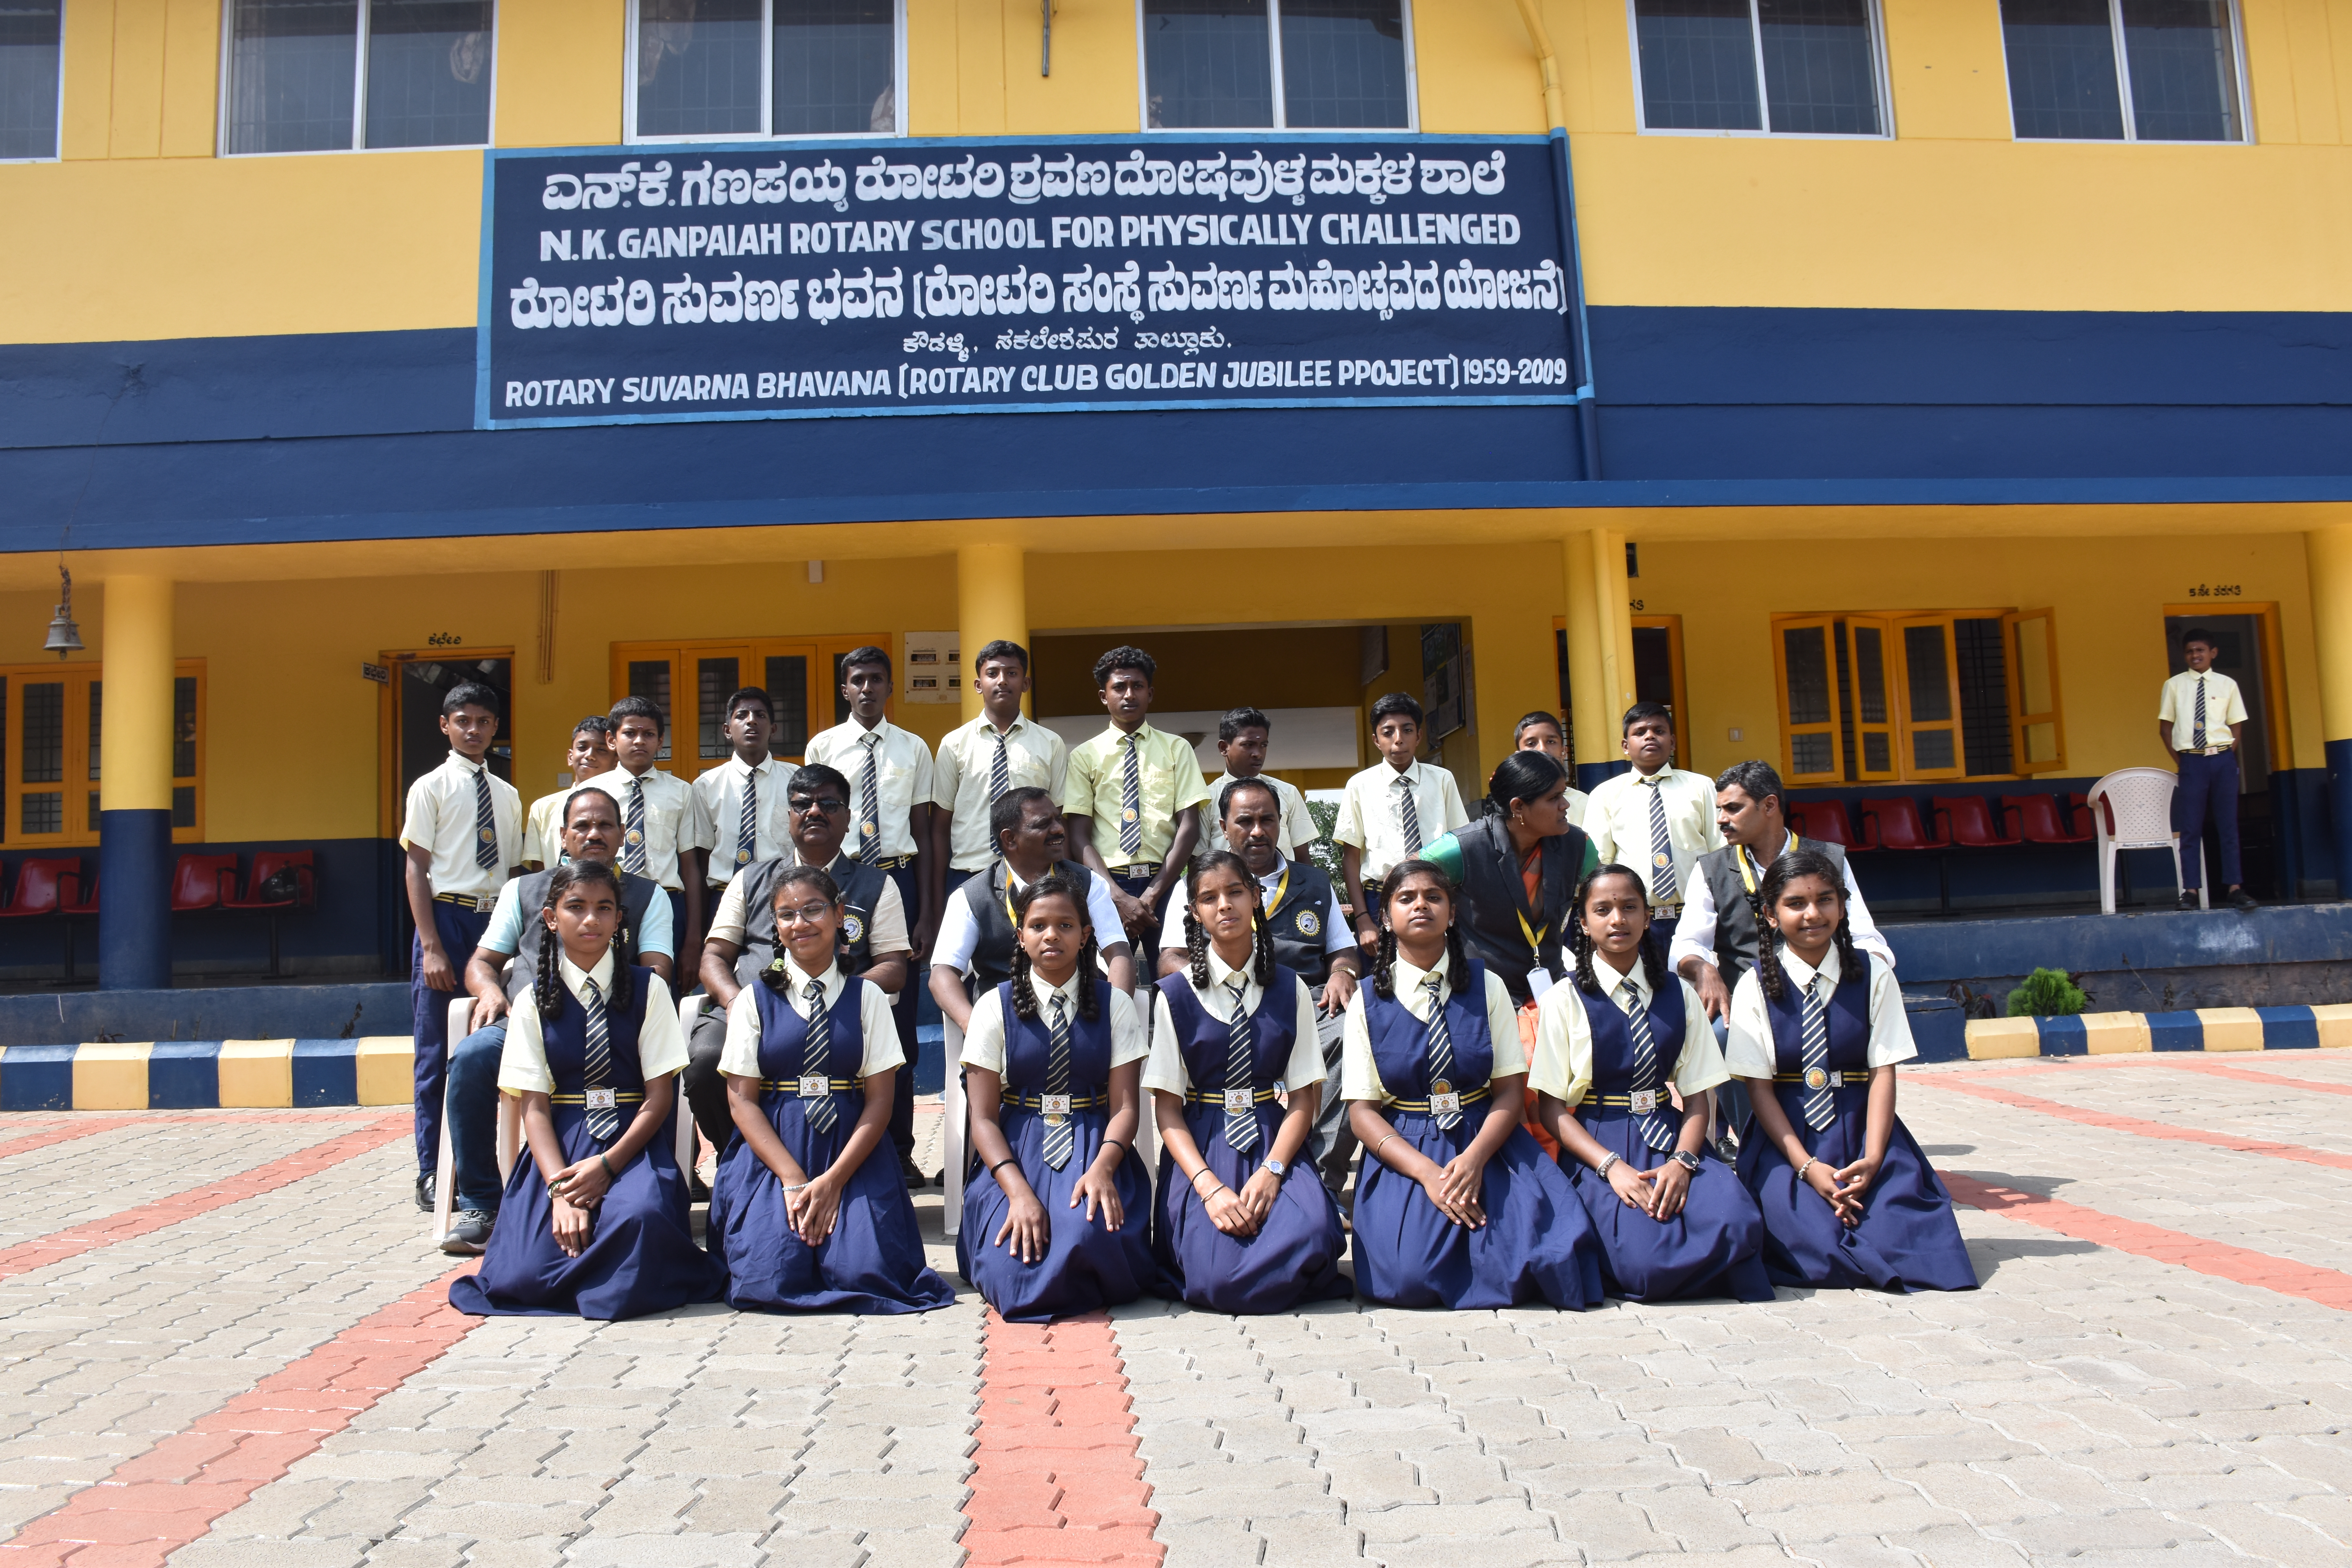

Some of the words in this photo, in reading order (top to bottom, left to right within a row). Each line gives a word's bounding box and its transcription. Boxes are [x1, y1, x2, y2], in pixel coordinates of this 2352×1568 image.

[855, 154, 1005, 201] ರೋಟರಿ
[1310, 152, 1415, 205] ಮಕ್ಕಳ
[1420, 150, 1506, 195] ಶಾಲೆ
[790, 221, 915, 254] ROTARY
[921, 218, 1045, 250] SCHOOL
[1051, 216, 1114, 248] FOR
[1120, 214, 1313, 247] PHYSICALLY
[1320, 213, 1521, 245] CHALLENGED
[510, 276, 656, 329] ರೋಟರಿ
[662, 271, 800, 325] ಸುವರ್ಣ
[806, 266, 904, 326] ಭವನ
[1063, 260, 1145, 325] ಸಂಸ್ಥೆ
[1148, 260, 1263, 312] ಸುವರ್ಣ
[505, 378, 615, 407] ROTARY
[622, 373, 750, 402] SUVARNA
[756, 369, 891, 398] BHAVANA
[1021, 364, 1098, 392] CLUB
[1105, 362, 1217, 390] GOLDEN
[1222, 360, 1332, 388] JUBILEE
[1463, 358, 1567, 385] 1959-2009
